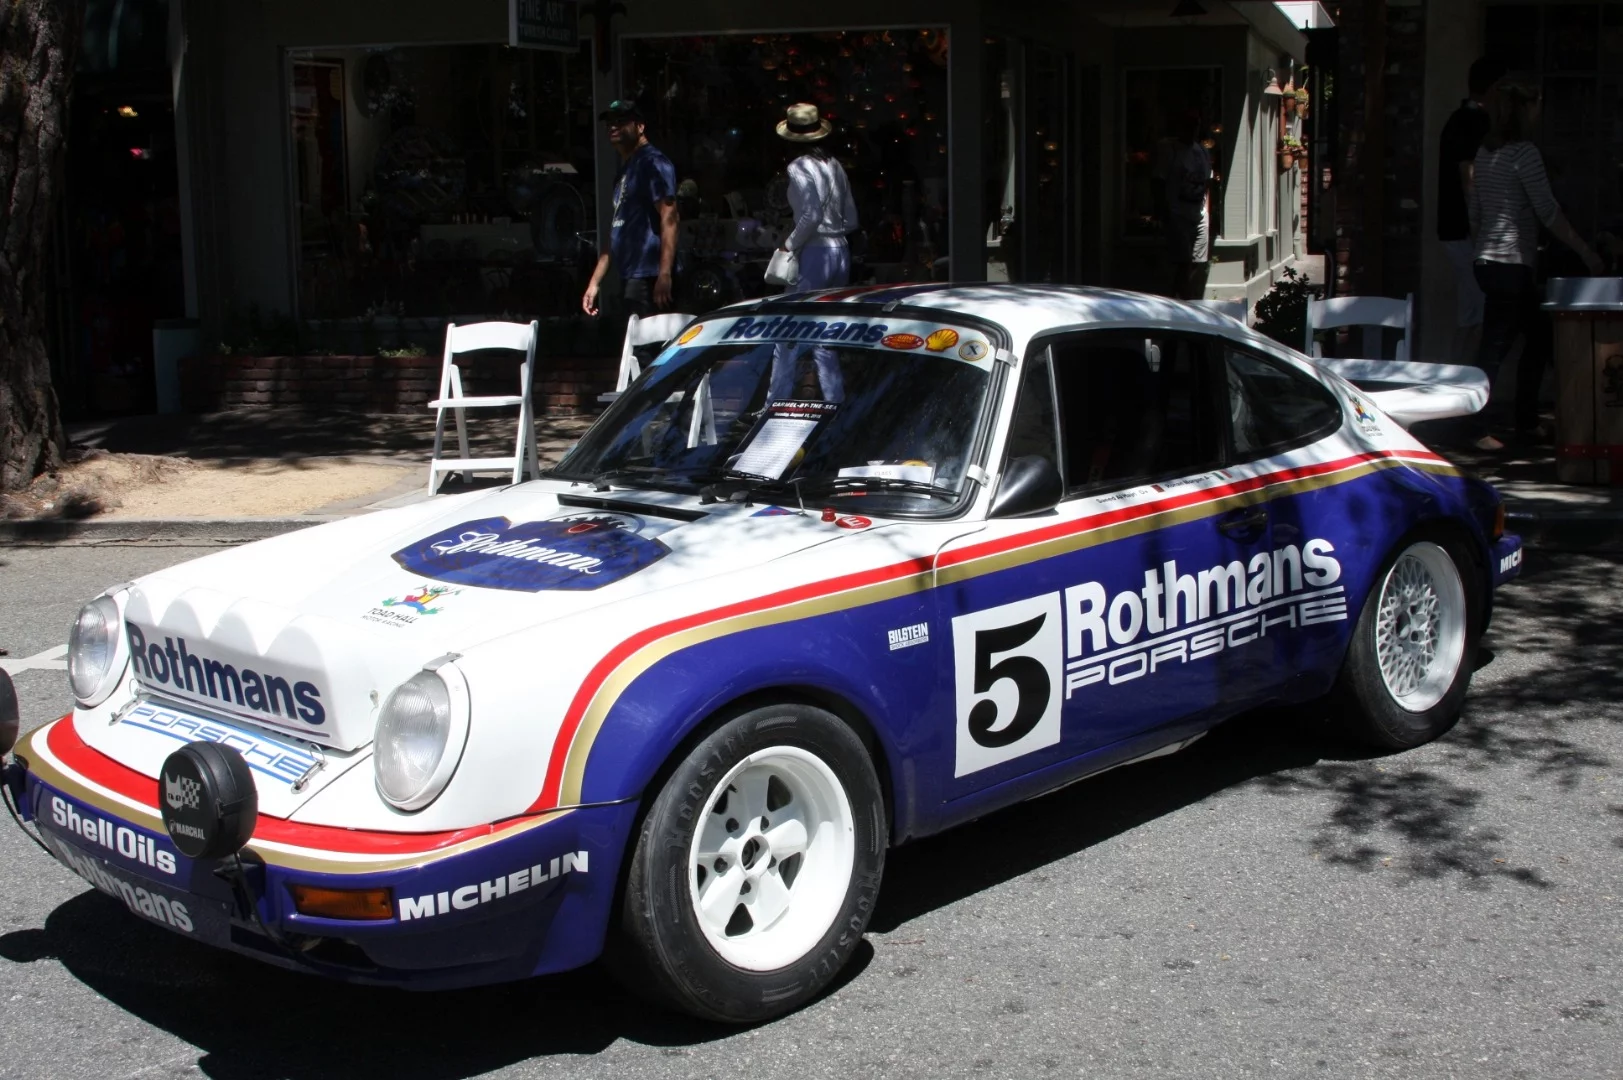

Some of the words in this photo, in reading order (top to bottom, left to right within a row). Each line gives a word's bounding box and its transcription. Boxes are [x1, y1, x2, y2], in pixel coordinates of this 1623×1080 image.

[545, 1, 565, 24] ART
[721, 315, 888, 343] Rothmans
[772, 402, 838, 410] CARMEL-BY-THE-SEA
[430, 531, 606, 575] Rothmans
[367, 607, 395, 617] TOAD
[391, 613, 419, 624] HALL
[1065, 538, 1341, 659] Rothmans
[887, 622, 929, 645] BILSTEIN
[1065, 596, 1348, 700] PORSCHE
[126, 621, 326, 725] Rothmans
[968, 612, 1051, 748] 5
[127, 706, 312, 778] PORSCHE
[52, 796, 114, 850] Shell
[116, 826, 177, 875] Oils
[175, 822, 206, 840] MARCHAL
[398, 850, 589, 921] MICHELIN
